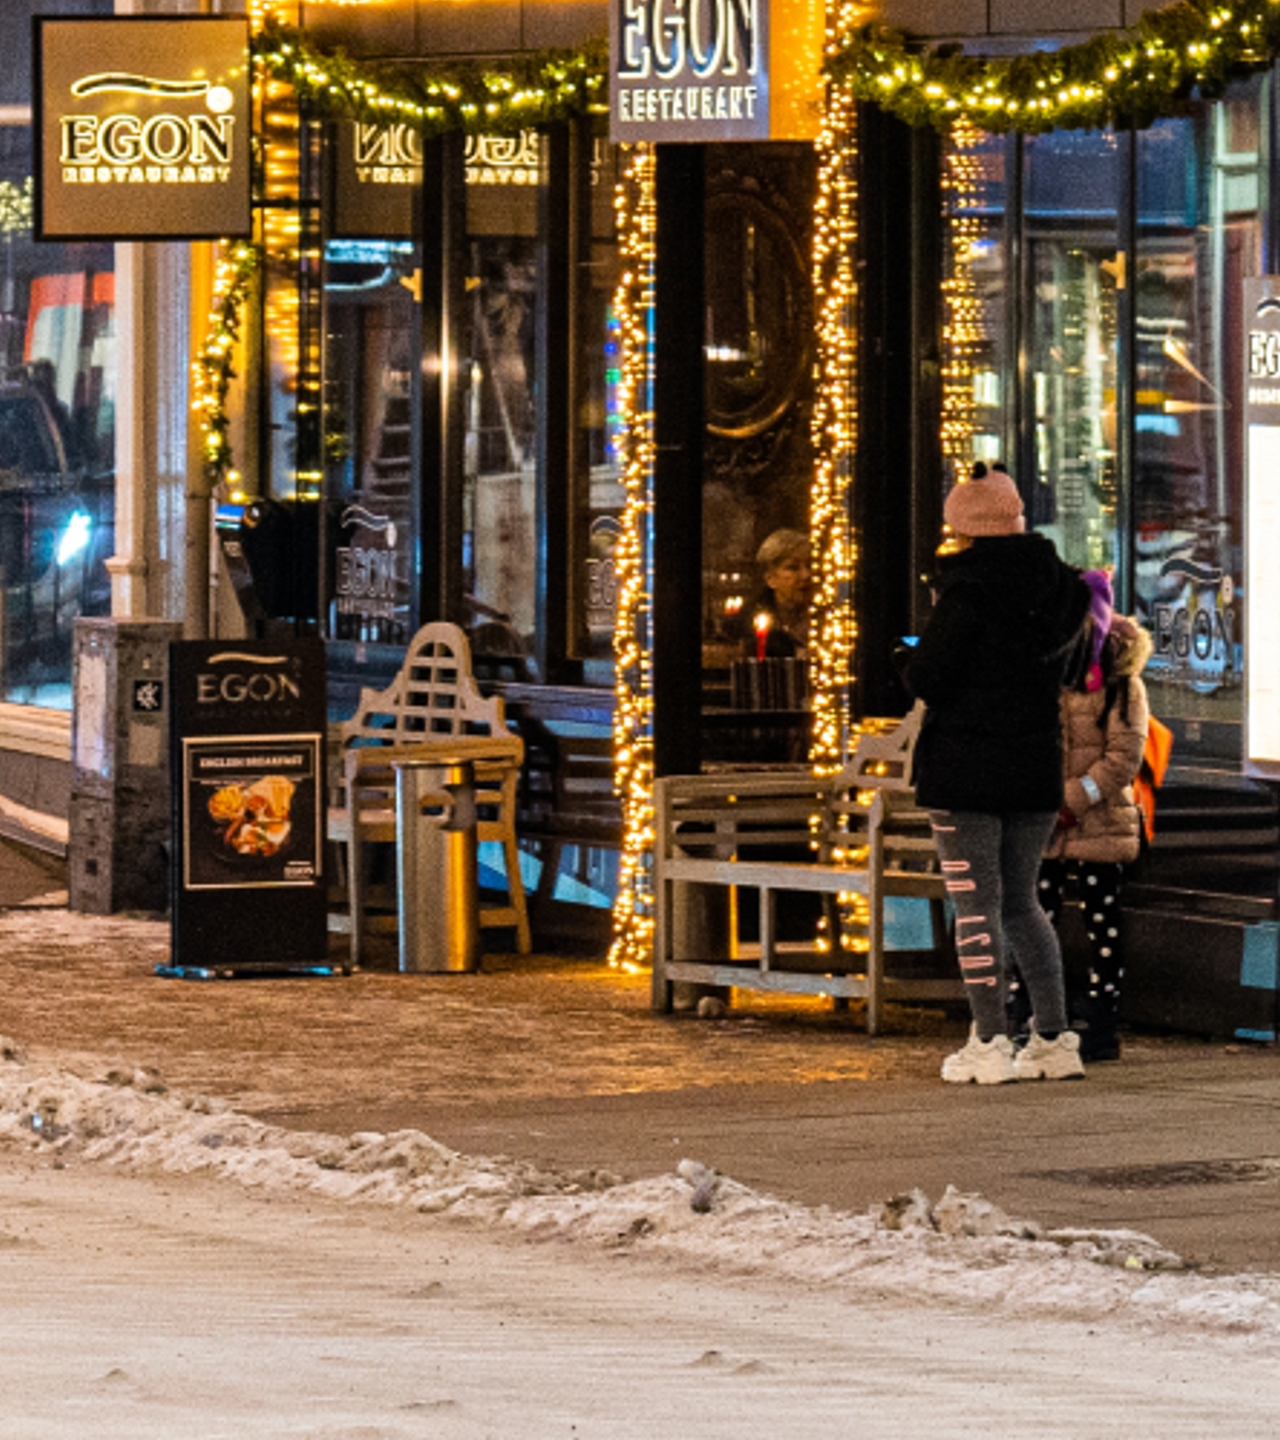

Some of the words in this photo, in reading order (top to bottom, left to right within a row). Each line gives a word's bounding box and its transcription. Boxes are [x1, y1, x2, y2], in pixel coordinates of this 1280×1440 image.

[618, 85, 757, 122] RESTAURANT
[60, 114, 235, 165] EGON
[62, 166, 230, 183] RESTAURANT
[335, 546, 397, 598] EGON
[1154, 606, 1236, 666] EGON
[196, 673, 301, 703] EGON
